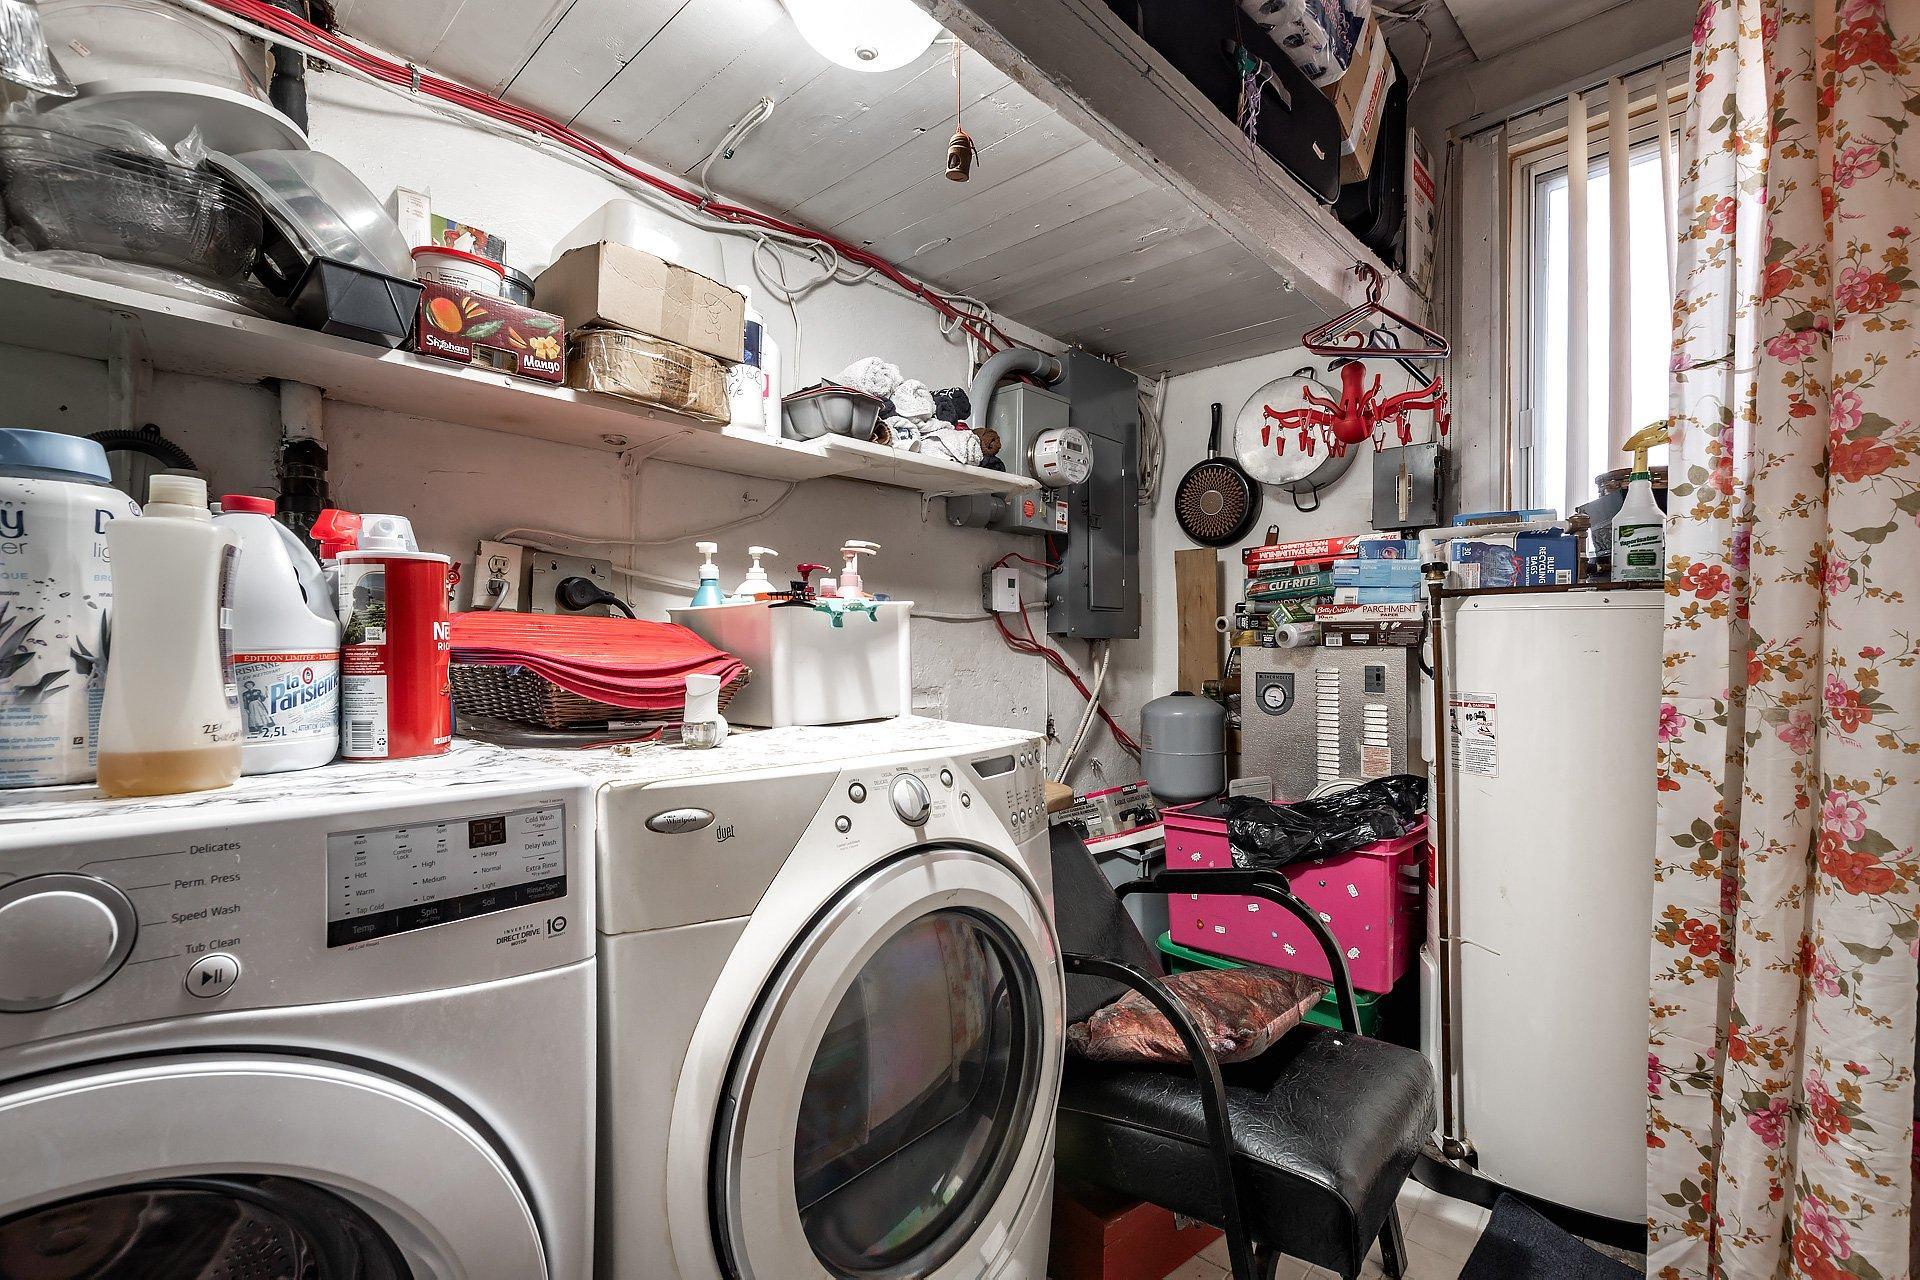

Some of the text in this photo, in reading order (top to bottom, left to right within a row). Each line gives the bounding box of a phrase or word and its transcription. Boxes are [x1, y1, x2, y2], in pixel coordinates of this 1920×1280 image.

[524, 355, 560, 373] Mango
[1530, 556, 1538, 575] BAGS
[1538, 546, 1547, 584] RECYCLING
[1269, 577, 1317, 590] CUT-RITE
[1316, 605, 1355, 614] Betty Crocker
[1362, 604, 1417, 613] PARCHMENT
[244, 654, 283, 662] ÉDITION
[285, 653, 315, 661] LIMITÉE
[286, 674, 300, 690] la
[262, 726, 287, 738] 2,5L
[525, 816, 538, 824] Cold
[665, 816, 697, 829] Whirlpool
[716, 824, 735, 842] duet
[190, 842, 241, 855] Delicates
[393, 848, 413, 856] Control
[421, 860, 436, 868] High
[481, 865, 502, 874] Normal
[525, 861, 558, 872] Extra Rinse
[174, 874, 241, 890] Perm. Press
[422, 876, 447, 885] Medium
[482, 882, 497, 890] Light
[355, 888, 376, 897] Warm
[369, 903, 385, 912] Cold
[421, 907, 438, 917] Spin
[171, 904, 241, 924] Speed Wash
[352, 924, 377, 935] Temp.
[503, 924, 535, 934] INVERTER
[546, 915, 567, 935] 10
[496, 927, 541, 945] DIRECT DRIVE
[185, 937, 241, 954] Tub Clean
[510, 939, 527, 947] MOTOR
